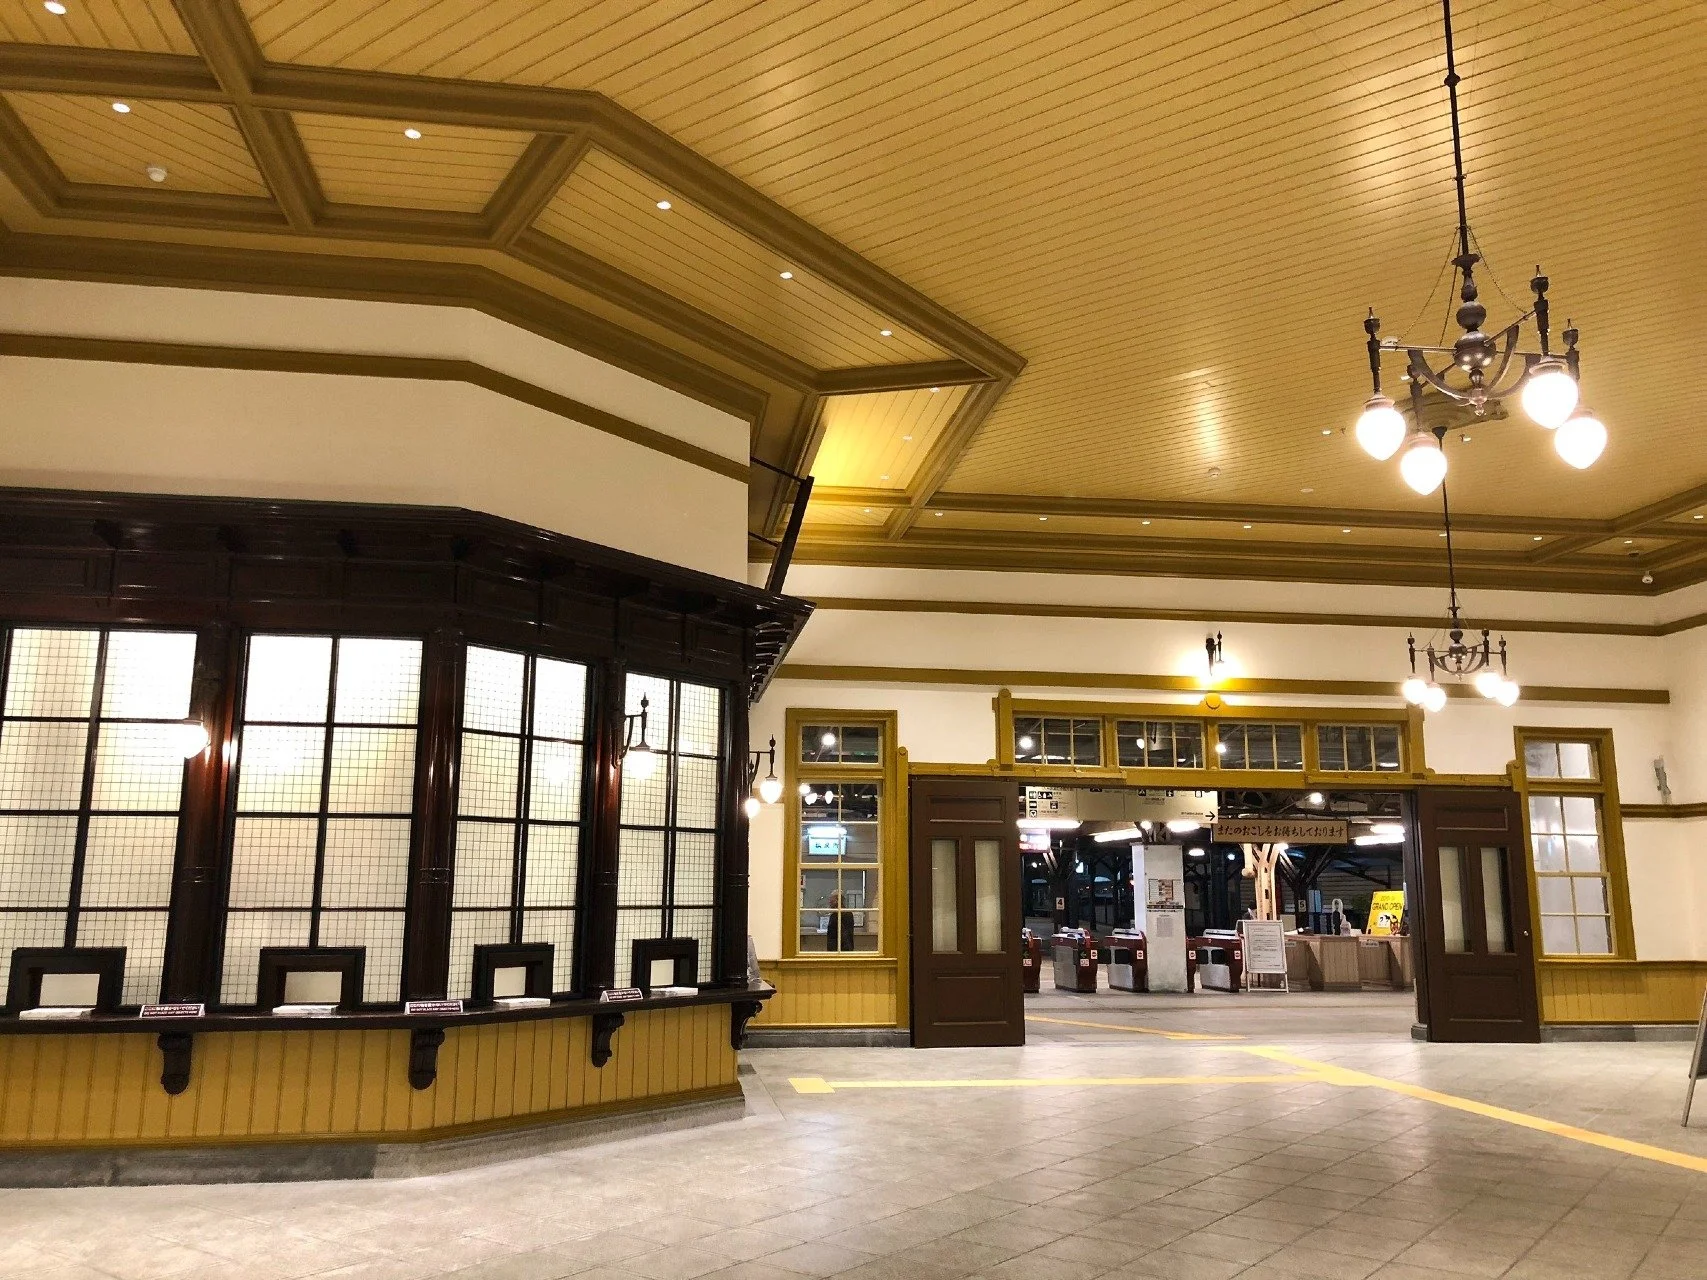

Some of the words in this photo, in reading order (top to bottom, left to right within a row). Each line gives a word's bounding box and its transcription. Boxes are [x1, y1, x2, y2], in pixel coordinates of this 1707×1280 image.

[1217, 825, 1344, 838] またのおこしをお待ちしております
[1372, 902, 1388, 911] GRAND
[1389, 902, 1403, 911] OPEN
